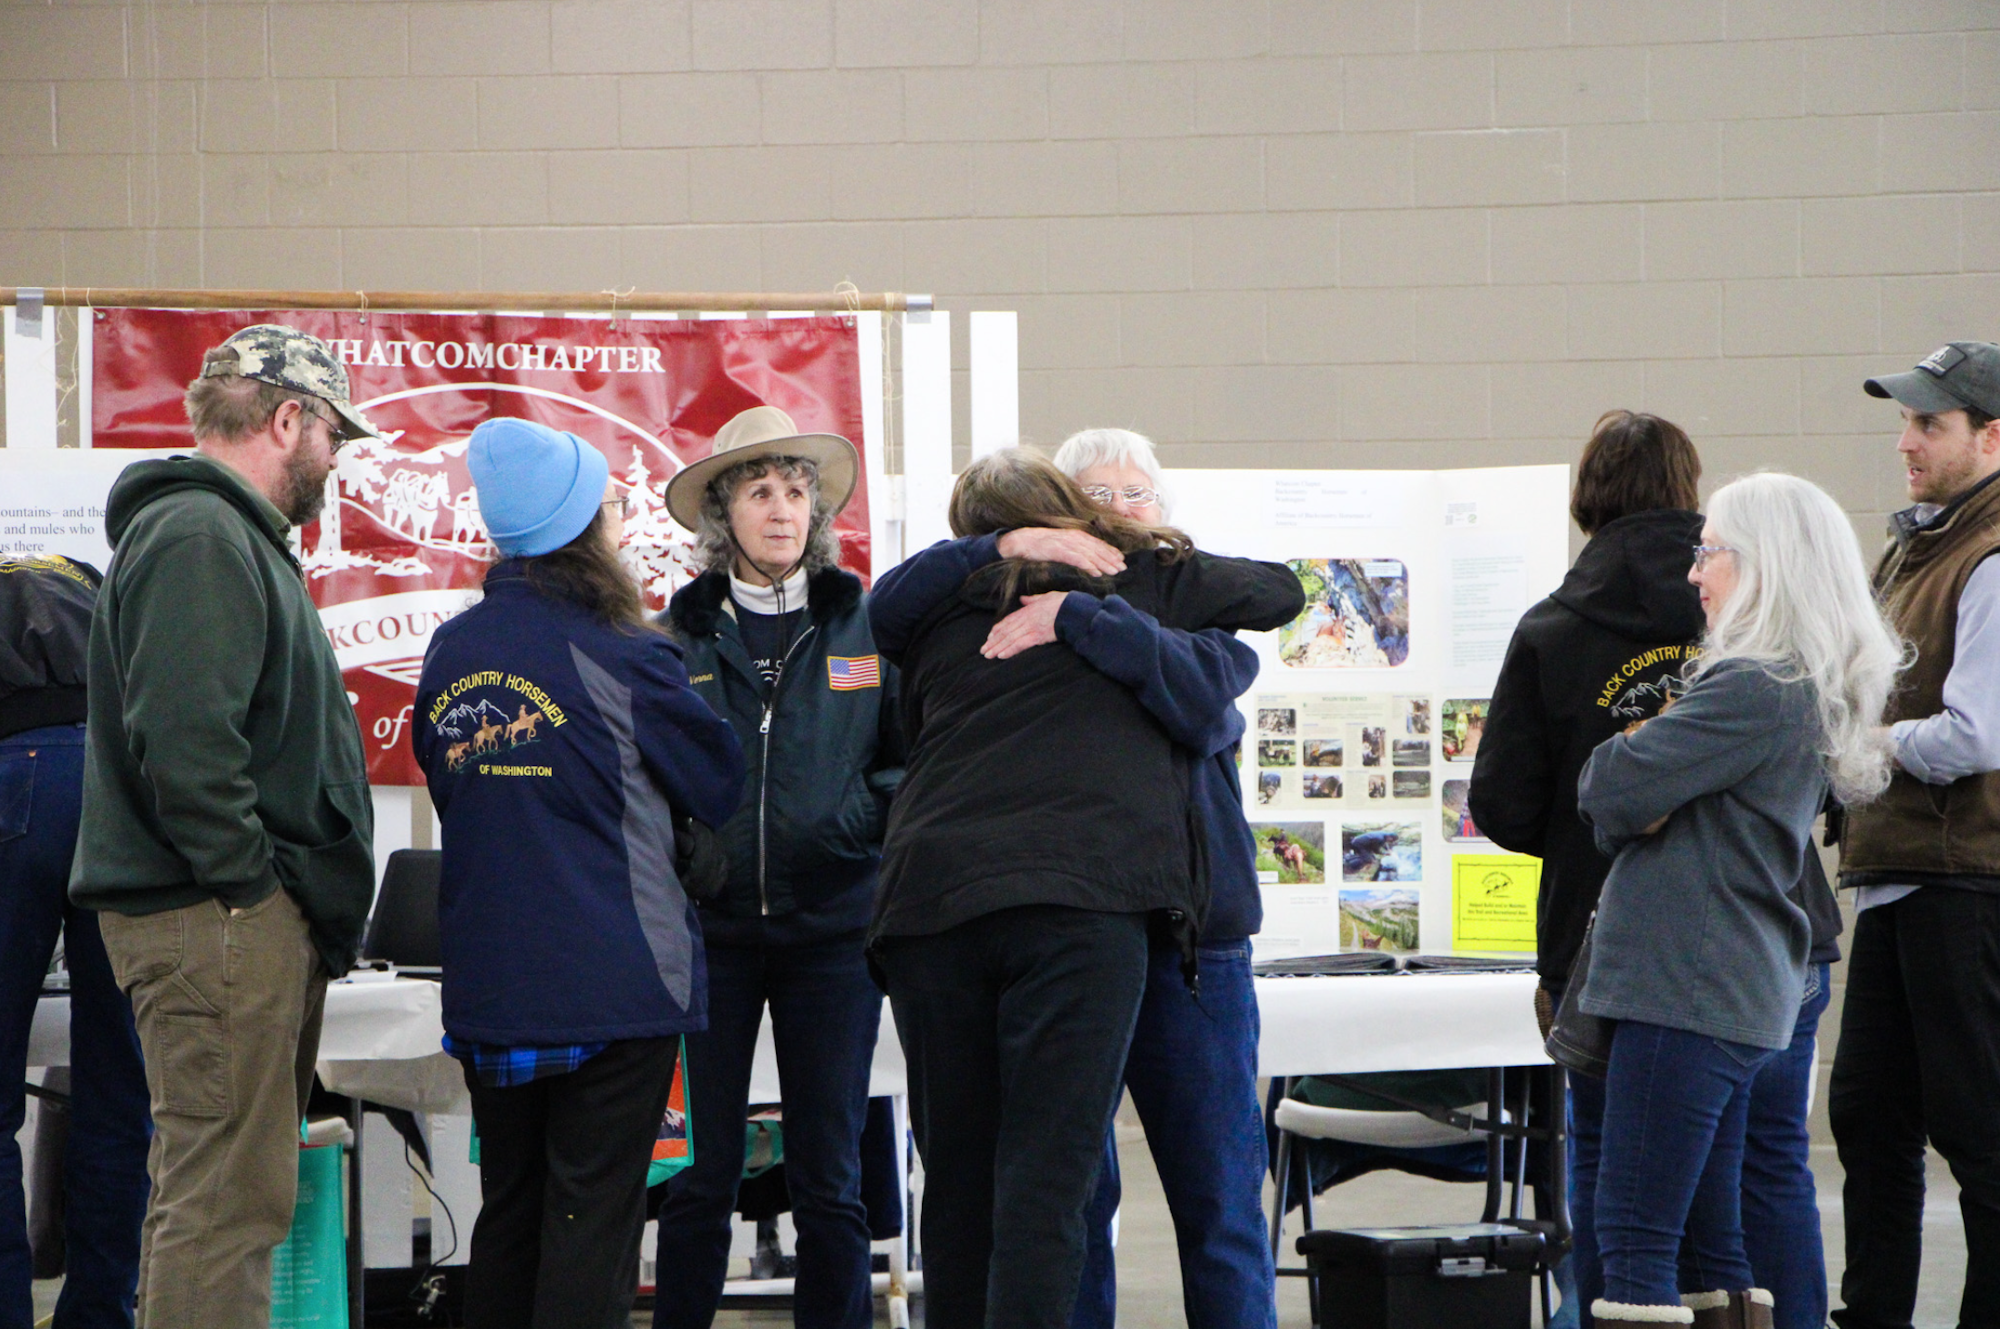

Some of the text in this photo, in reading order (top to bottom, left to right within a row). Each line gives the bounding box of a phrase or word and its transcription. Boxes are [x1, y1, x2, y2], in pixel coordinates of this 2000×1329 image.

[62, 506, 84, 518] and
[4, 523, 95, 535] and mules who
[14, 540, 45, 552] there
[1597, 672, 1627, 707] BACK
[1621, 645, 1682, 677] COUNTRY
[429, 670, 568, 728] BACK COUNTRY HORSEMEN
[373, 704, 415, 750] of
[479, 764, 552, 777] OF WASHINGTON
